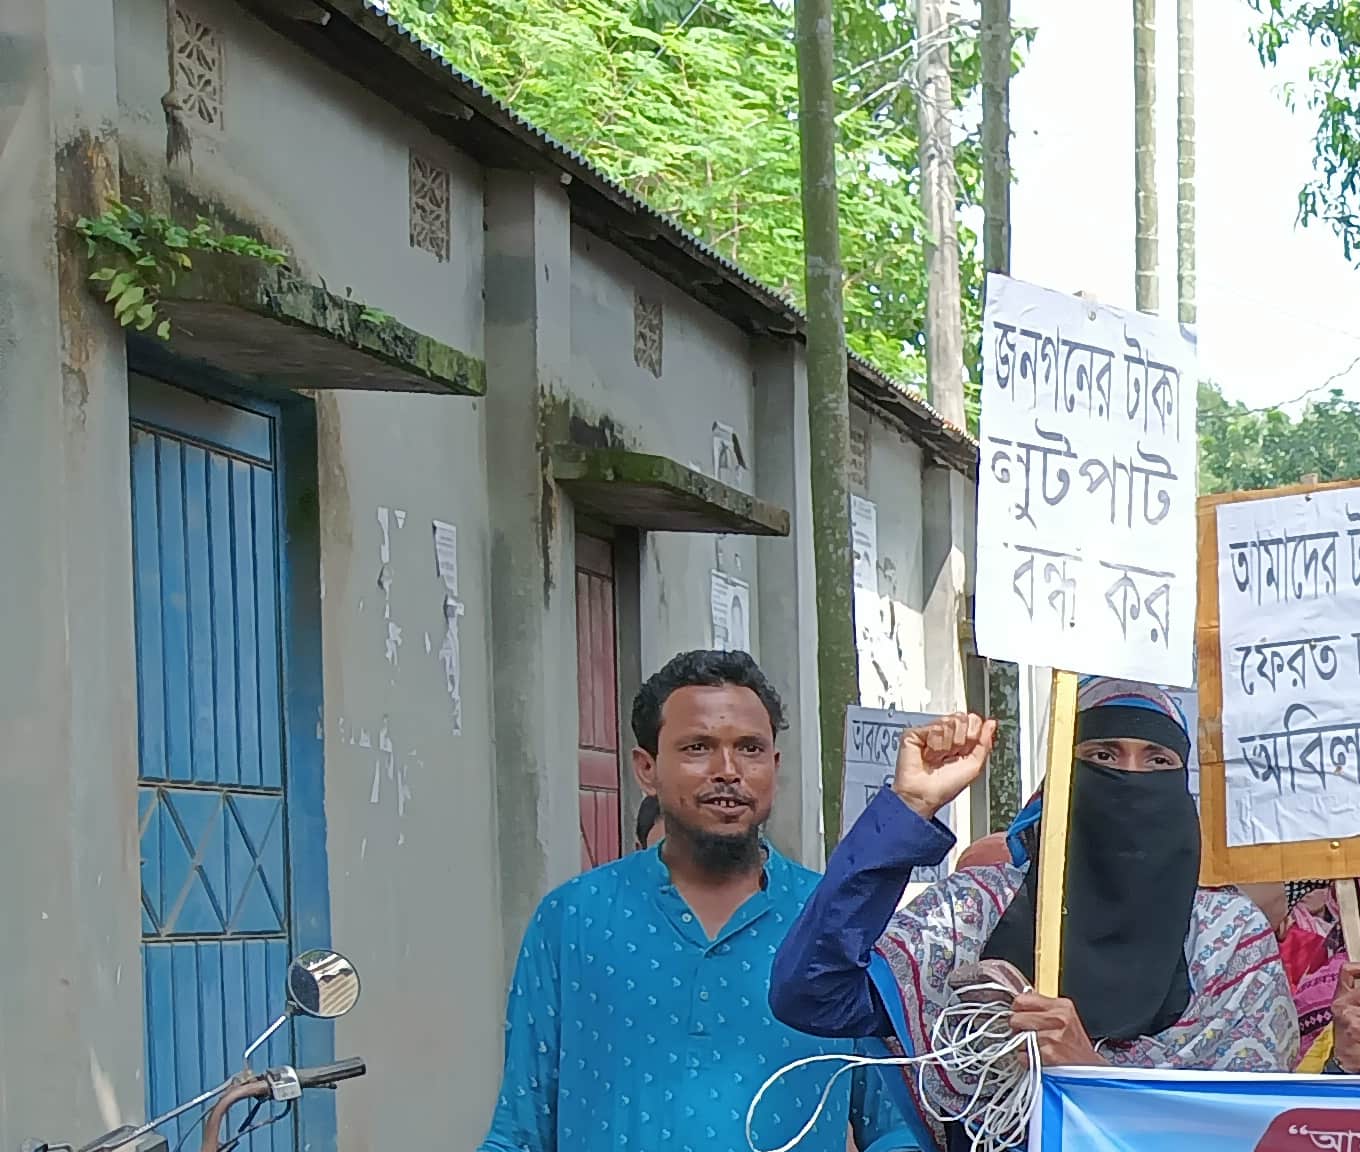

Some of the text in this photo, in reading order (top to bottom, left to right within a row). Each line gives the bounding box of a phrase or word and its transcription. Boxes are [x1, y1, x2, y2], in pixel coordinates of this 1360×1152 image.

[993, 322, 1182, 441] জনগনের টাকা
[988, 418, 1178, 528] লুটপাট
[1013, 545, 1176, 650] বন্ধ কর
[1229, 528, 1340, 605] আমাদের
[1235, 636, 1341, 695] ফেরত
